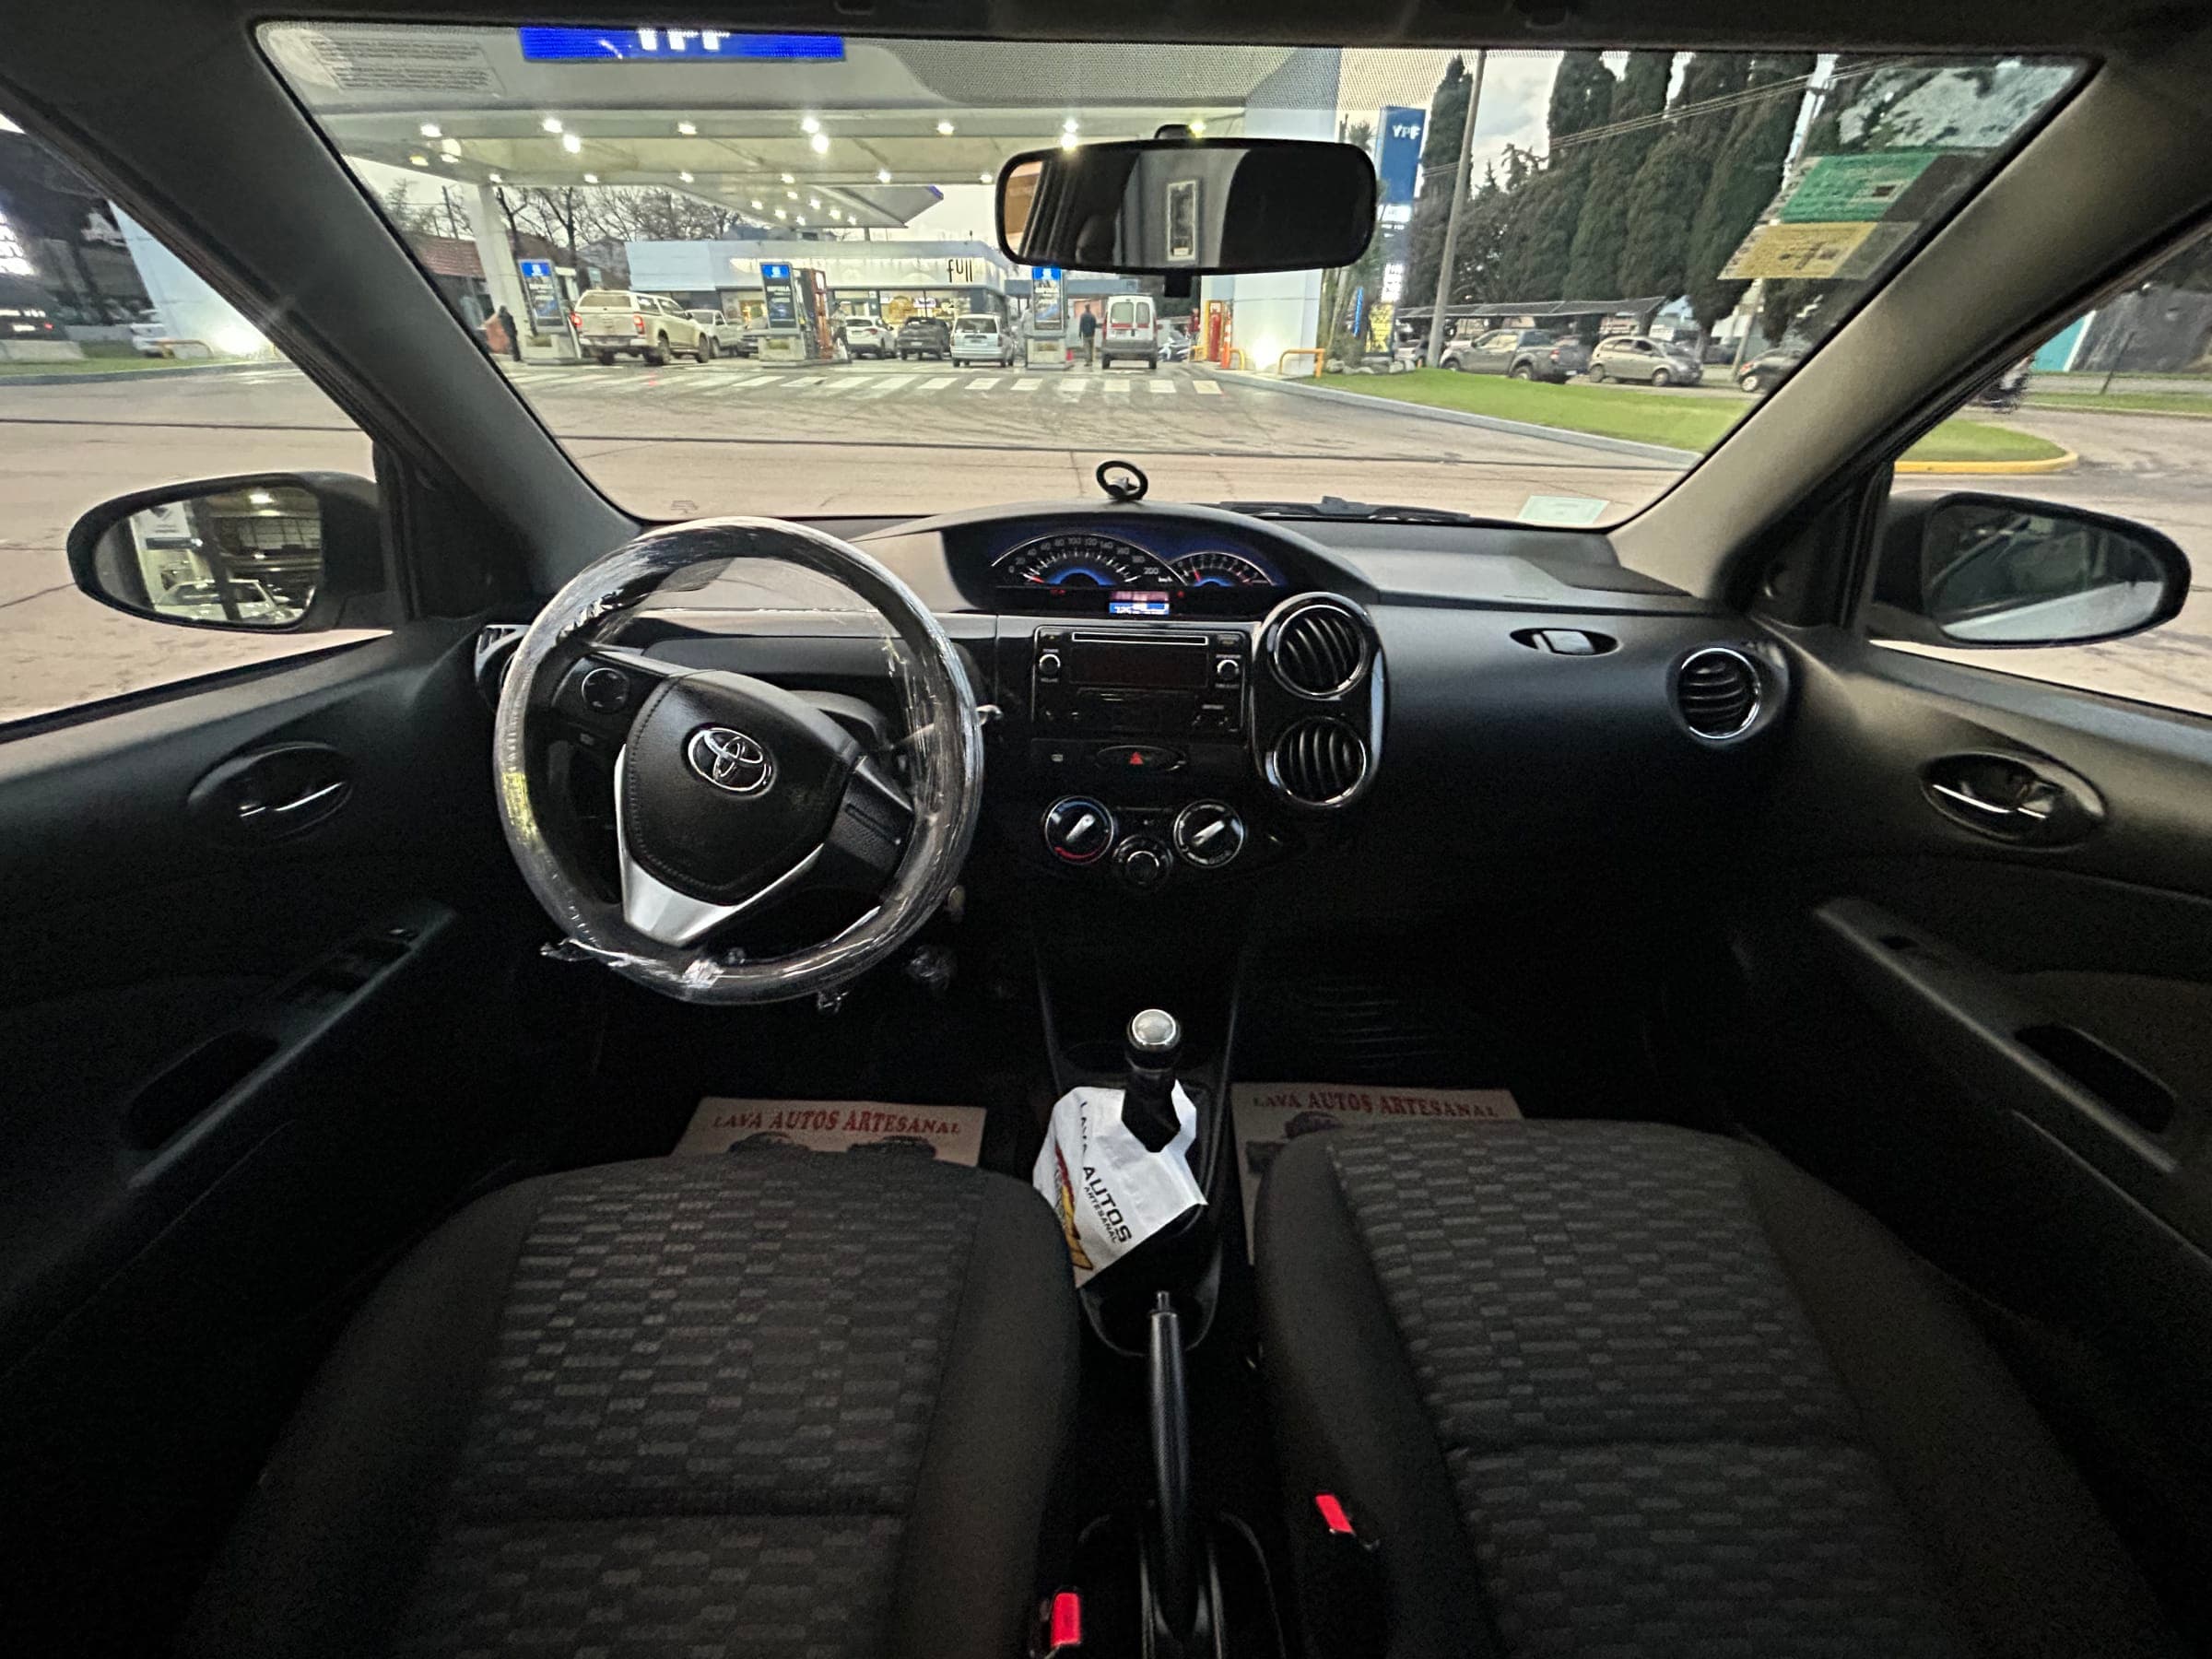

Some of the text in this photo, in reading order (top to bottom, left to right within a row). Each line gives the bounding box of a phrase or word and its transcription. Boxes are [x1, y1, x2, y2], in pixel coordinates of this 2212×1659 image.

[1393, 124, 1420, 140] YPF
[947, 258, 973, 283] full
[1067, 537, 1082, 547] 100
[1143, 567, 1159, 575] 200
[1308, 1091, 1373, 1112] AUTOS
[1379, 1095, 1499, 1117] ARTESANAL
[712, 1110, 961, 1134] LAVA AUTOS ARTESANAL
[1083, 1166, 1133, 1244] AUTOS
[1084, 1186, 1119, 1244] ARTESANAL
